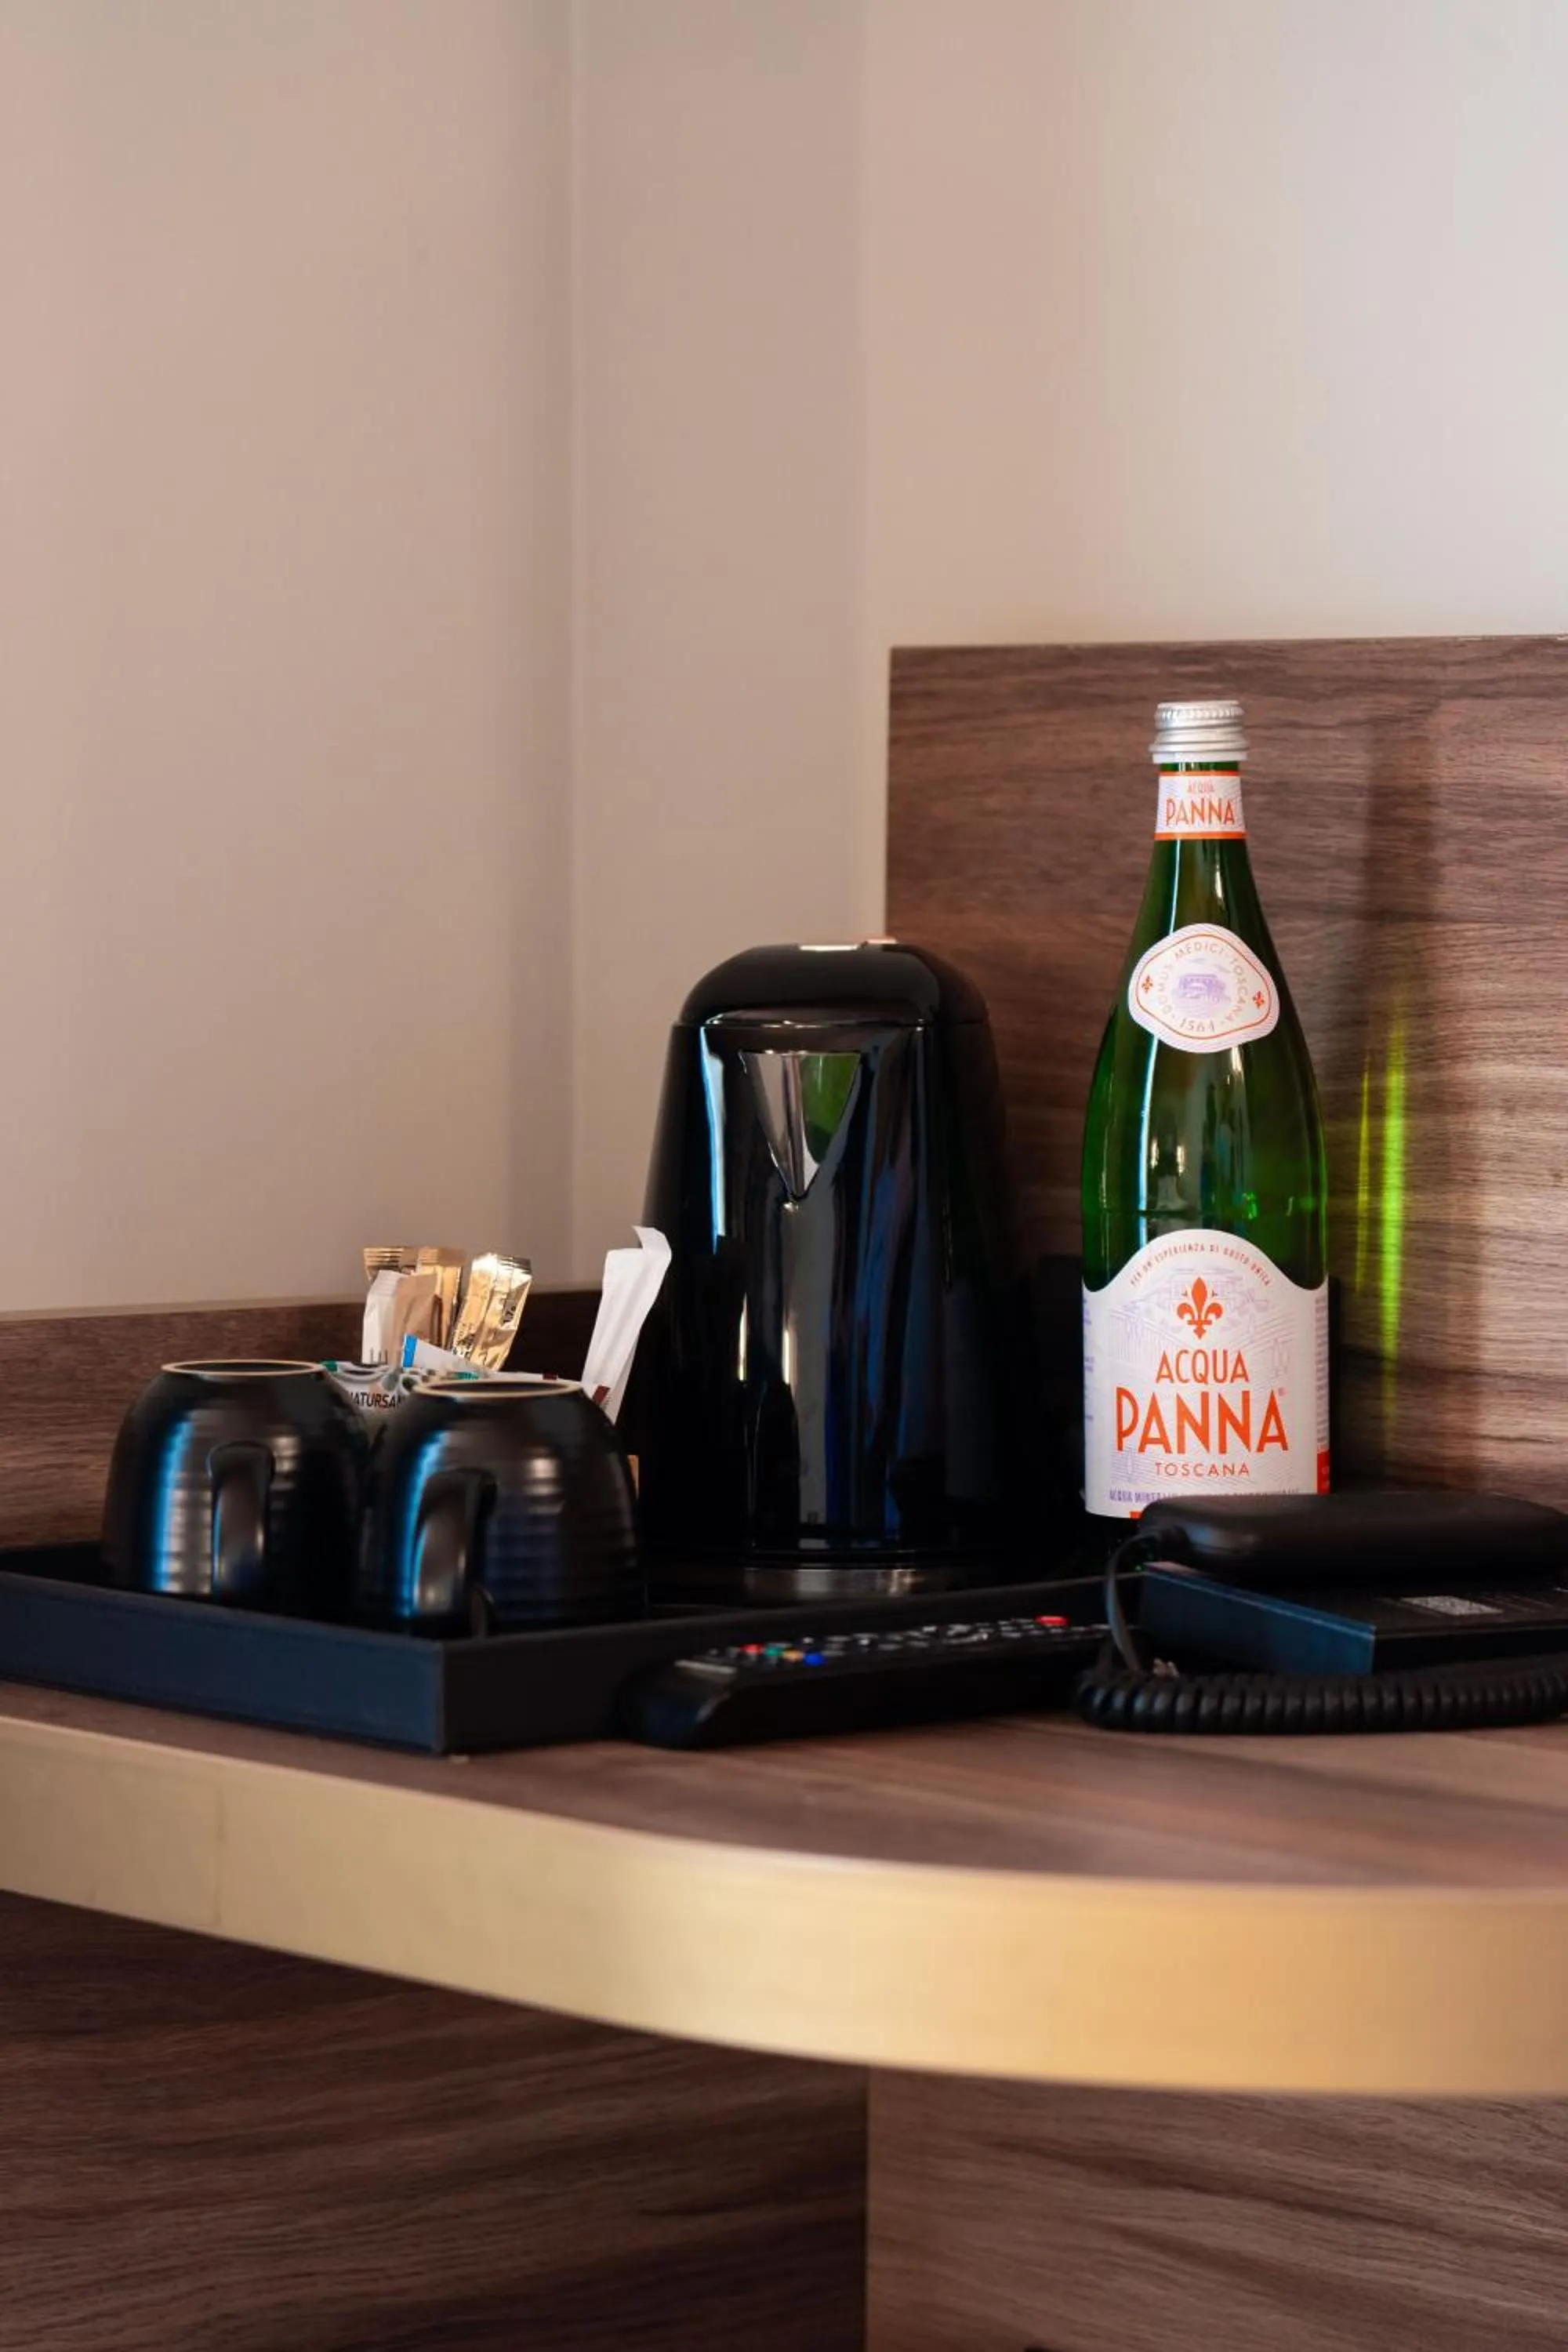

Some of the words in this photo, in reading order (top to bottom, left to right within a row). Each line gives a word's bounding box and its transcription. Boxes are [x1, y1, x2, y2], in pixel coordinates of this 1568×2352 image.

[1166, 797, 1235, 825] PANNA
[1156, 1350, 1249, 1385] ACQUA
[1116, 1386, 1289, 1454] PANNA
[1155, 1462, 1250, 1477] TOSCANA
